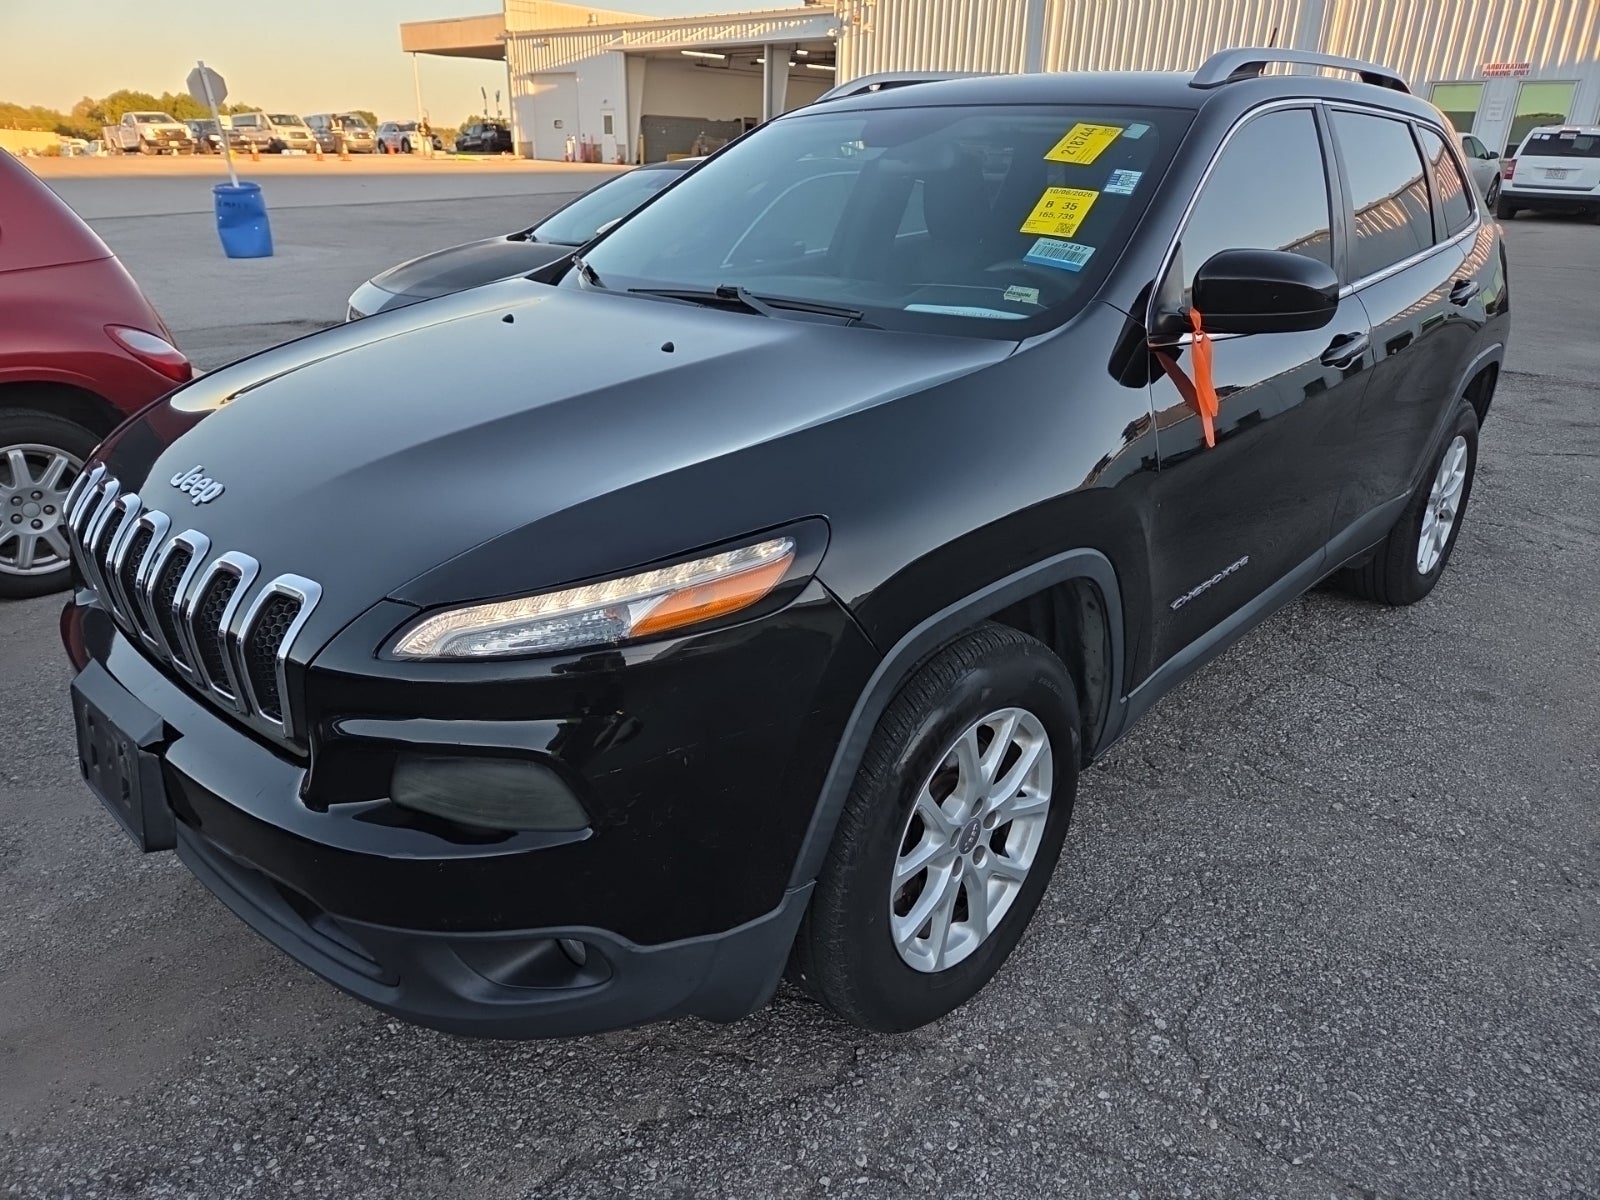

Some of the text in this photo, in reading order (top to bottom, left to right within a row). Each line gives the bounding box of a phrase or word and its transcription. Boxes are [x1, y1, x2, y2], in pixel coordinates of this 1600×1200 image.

[1061, 127, 1097, 155] 218744
[1045, 200, 1079, 211] B 35
[170, 464, 225, 506] Jeep
